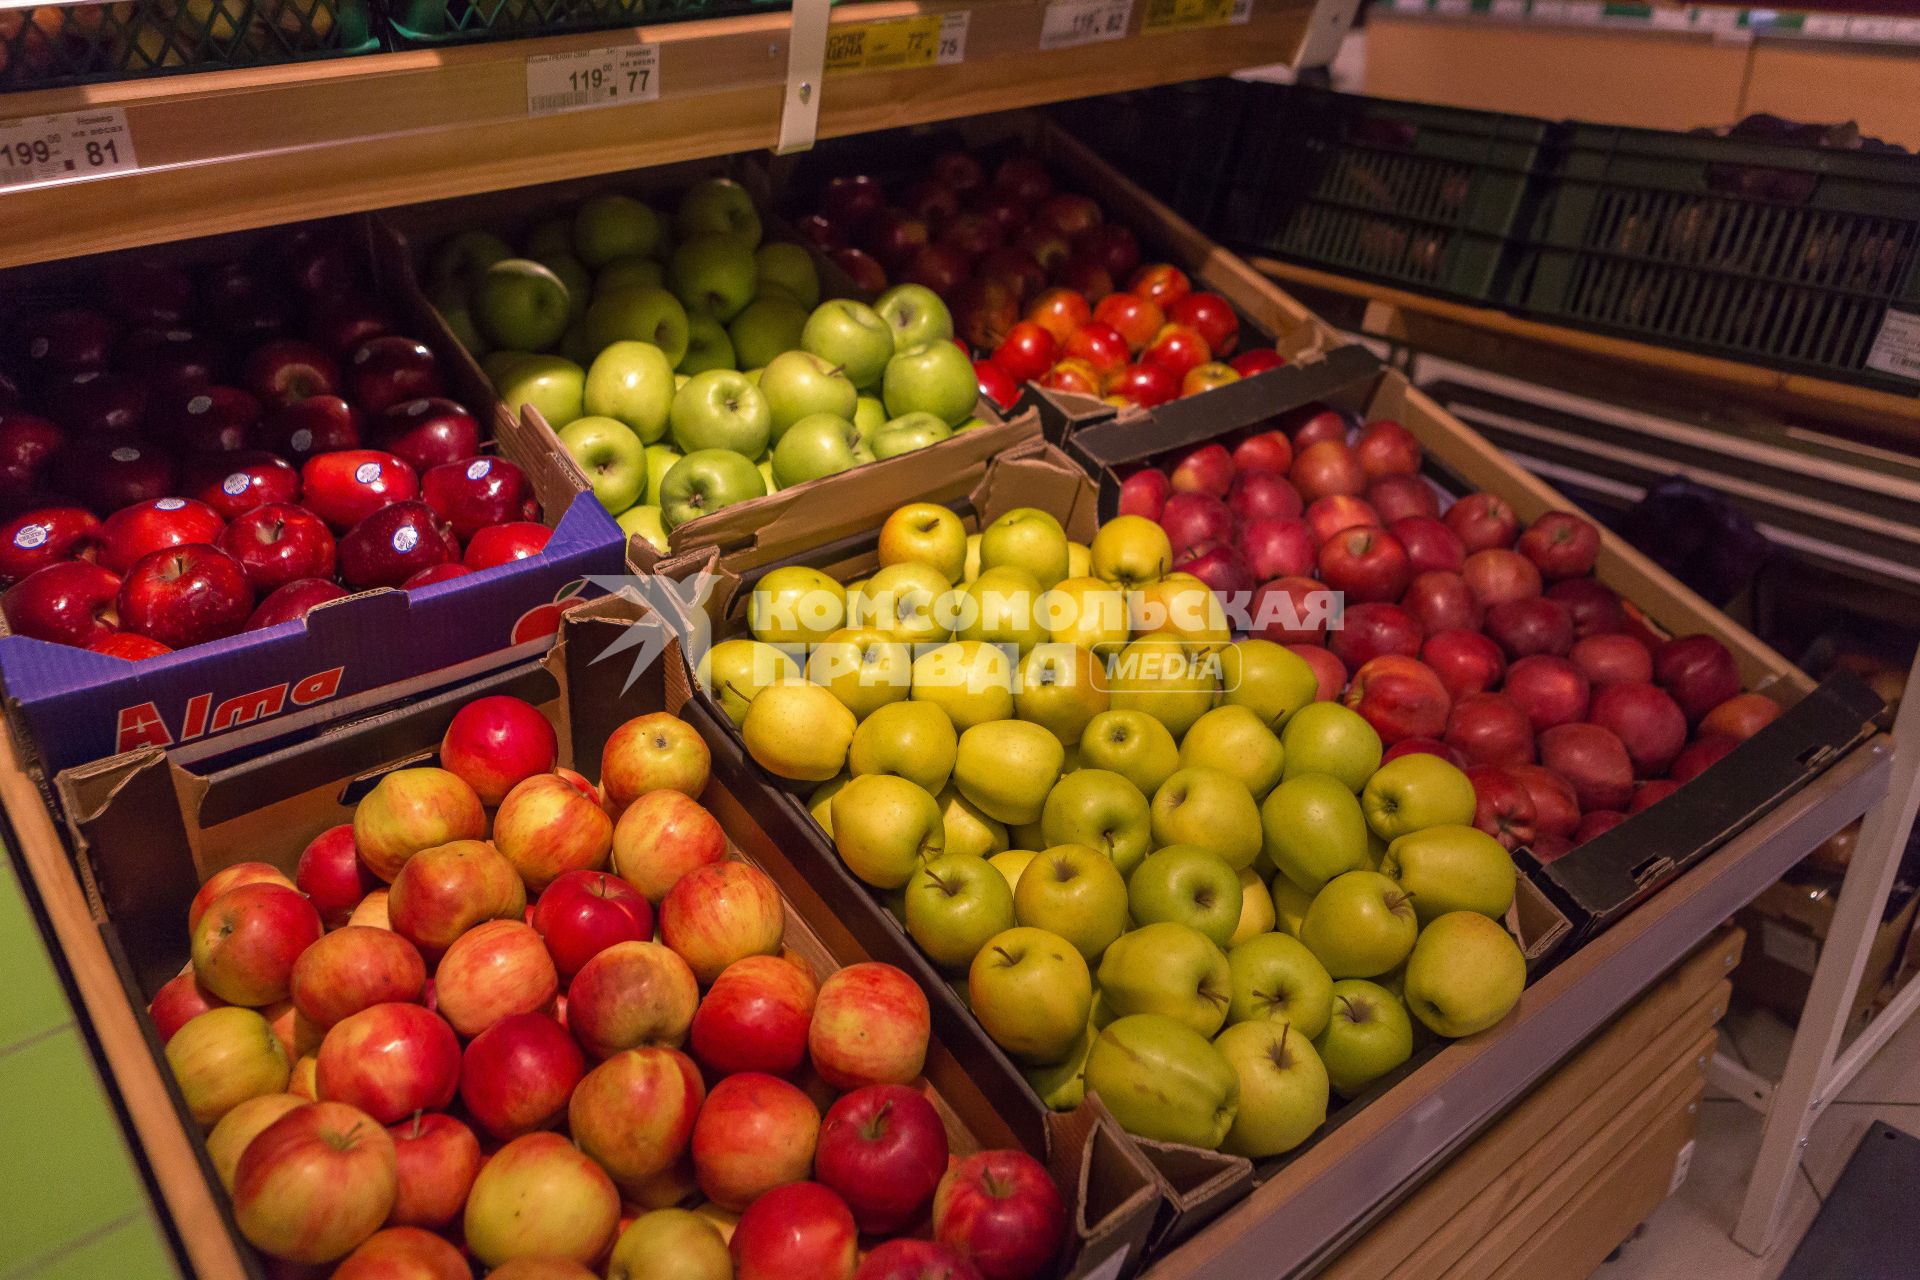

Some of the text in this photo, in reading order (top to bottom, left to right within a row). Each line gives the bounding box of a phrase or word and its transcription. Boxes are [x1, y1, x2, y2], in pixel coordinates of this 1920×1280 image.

[569, 68, 603, 91] 119
[627, 70, 650, 93] 77
[0, 140, 50, 167] 199
[86, 139, 119, 167] 81
[115, 666, 345, 755] Alma
